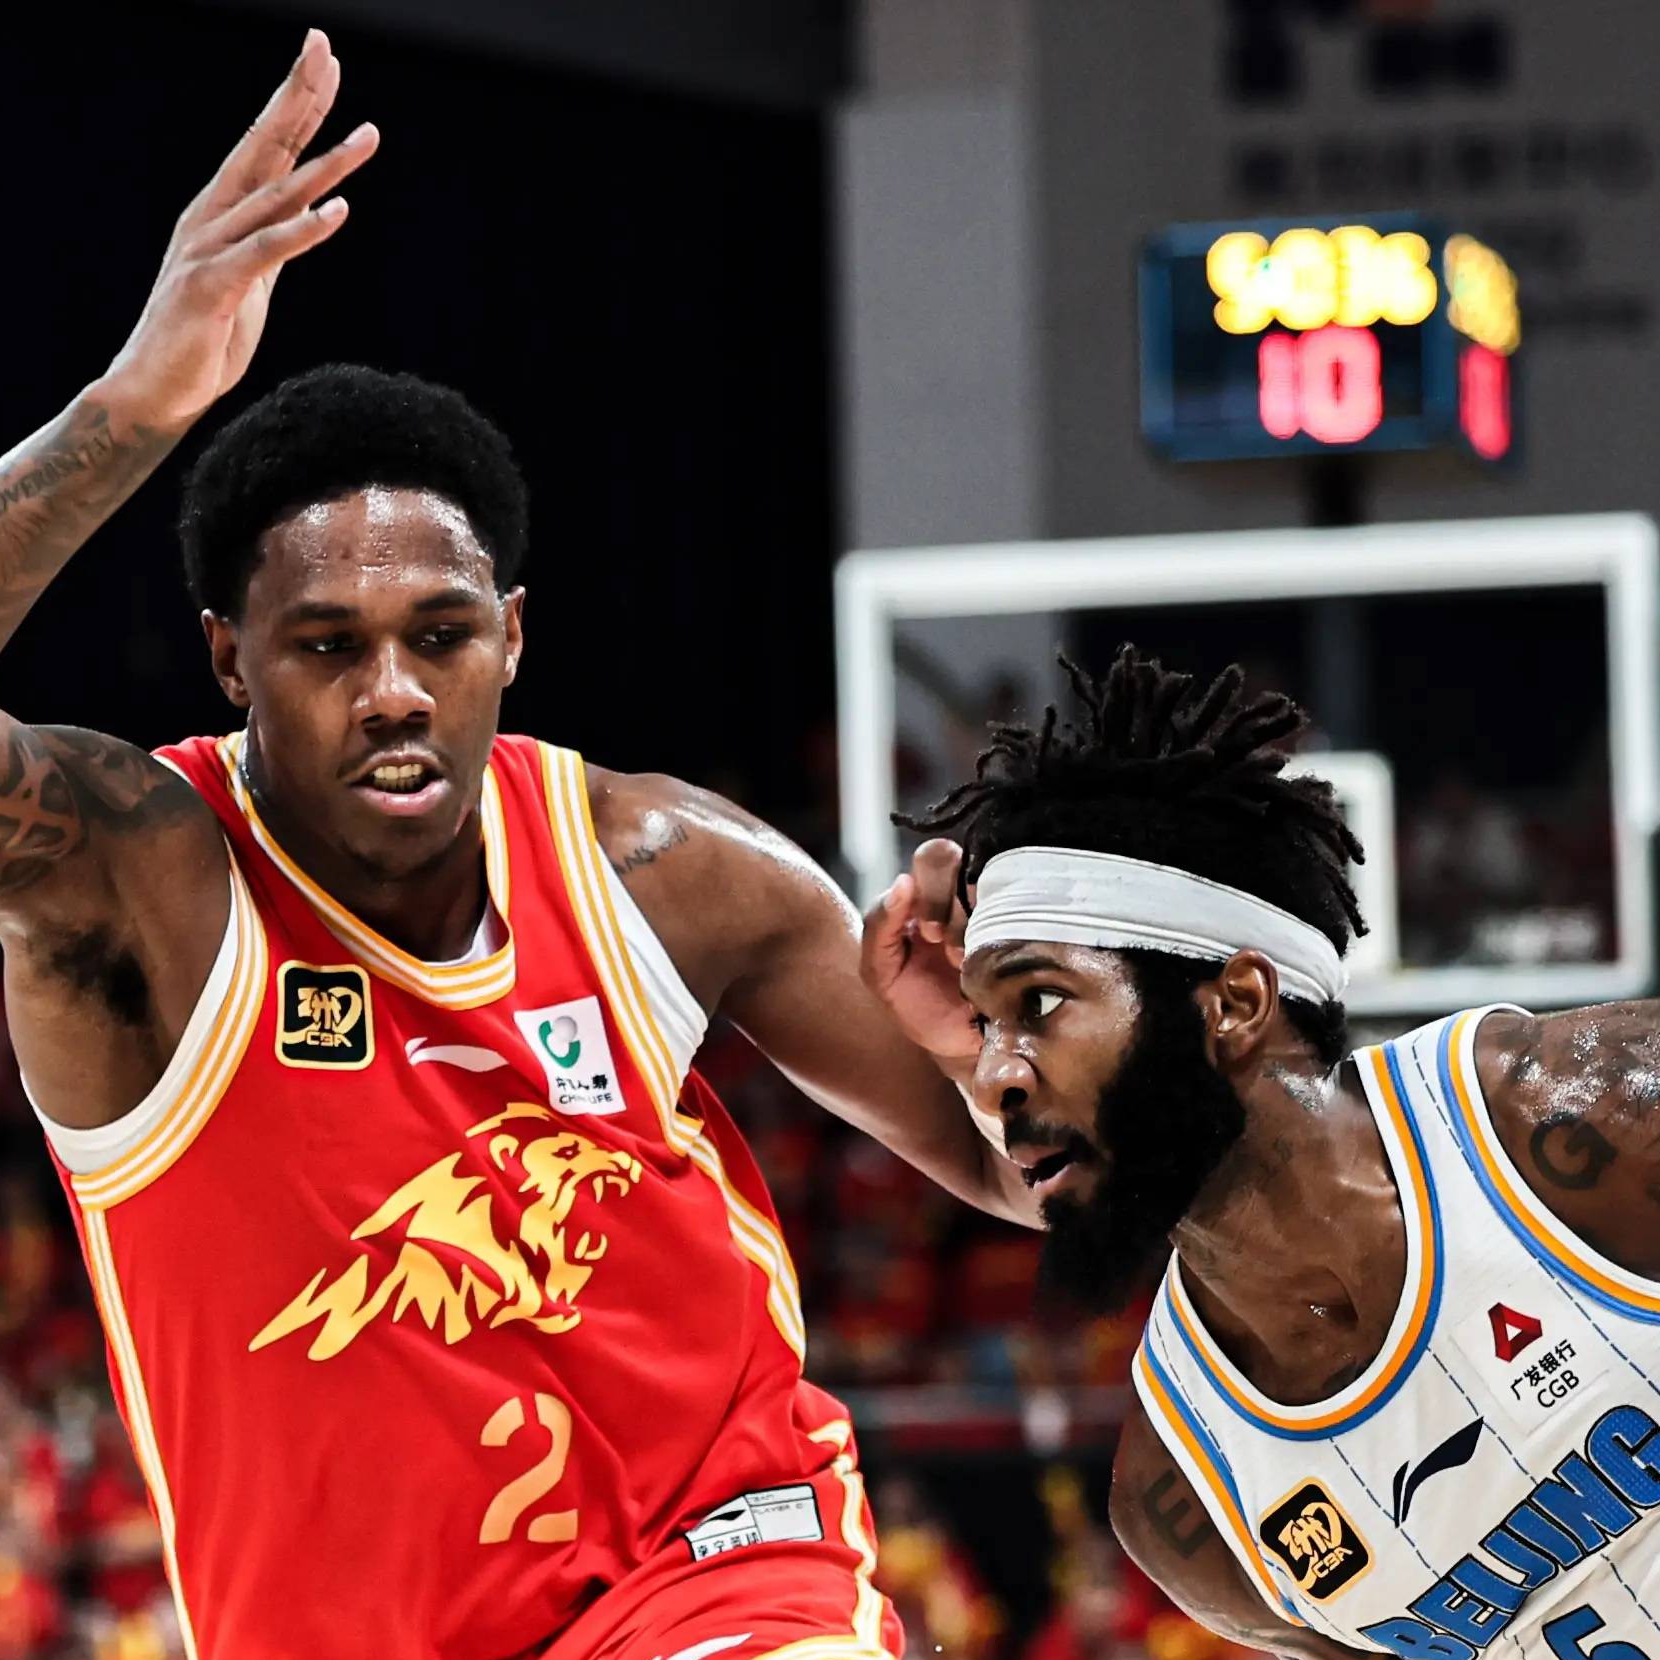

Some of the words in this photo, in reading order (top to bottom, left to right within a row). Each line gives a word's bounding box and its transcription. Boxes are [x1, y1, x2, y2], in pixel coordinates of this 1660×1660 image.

[1258, 325, 1382, 443] 10
[1510, 1338, 1577, 1401] 广发银行
[1537, 1369, 1580, 1409] CGB
[479, 1392, 578, 1544] 2
[1311, 1546, 1354, 1578] CBA
